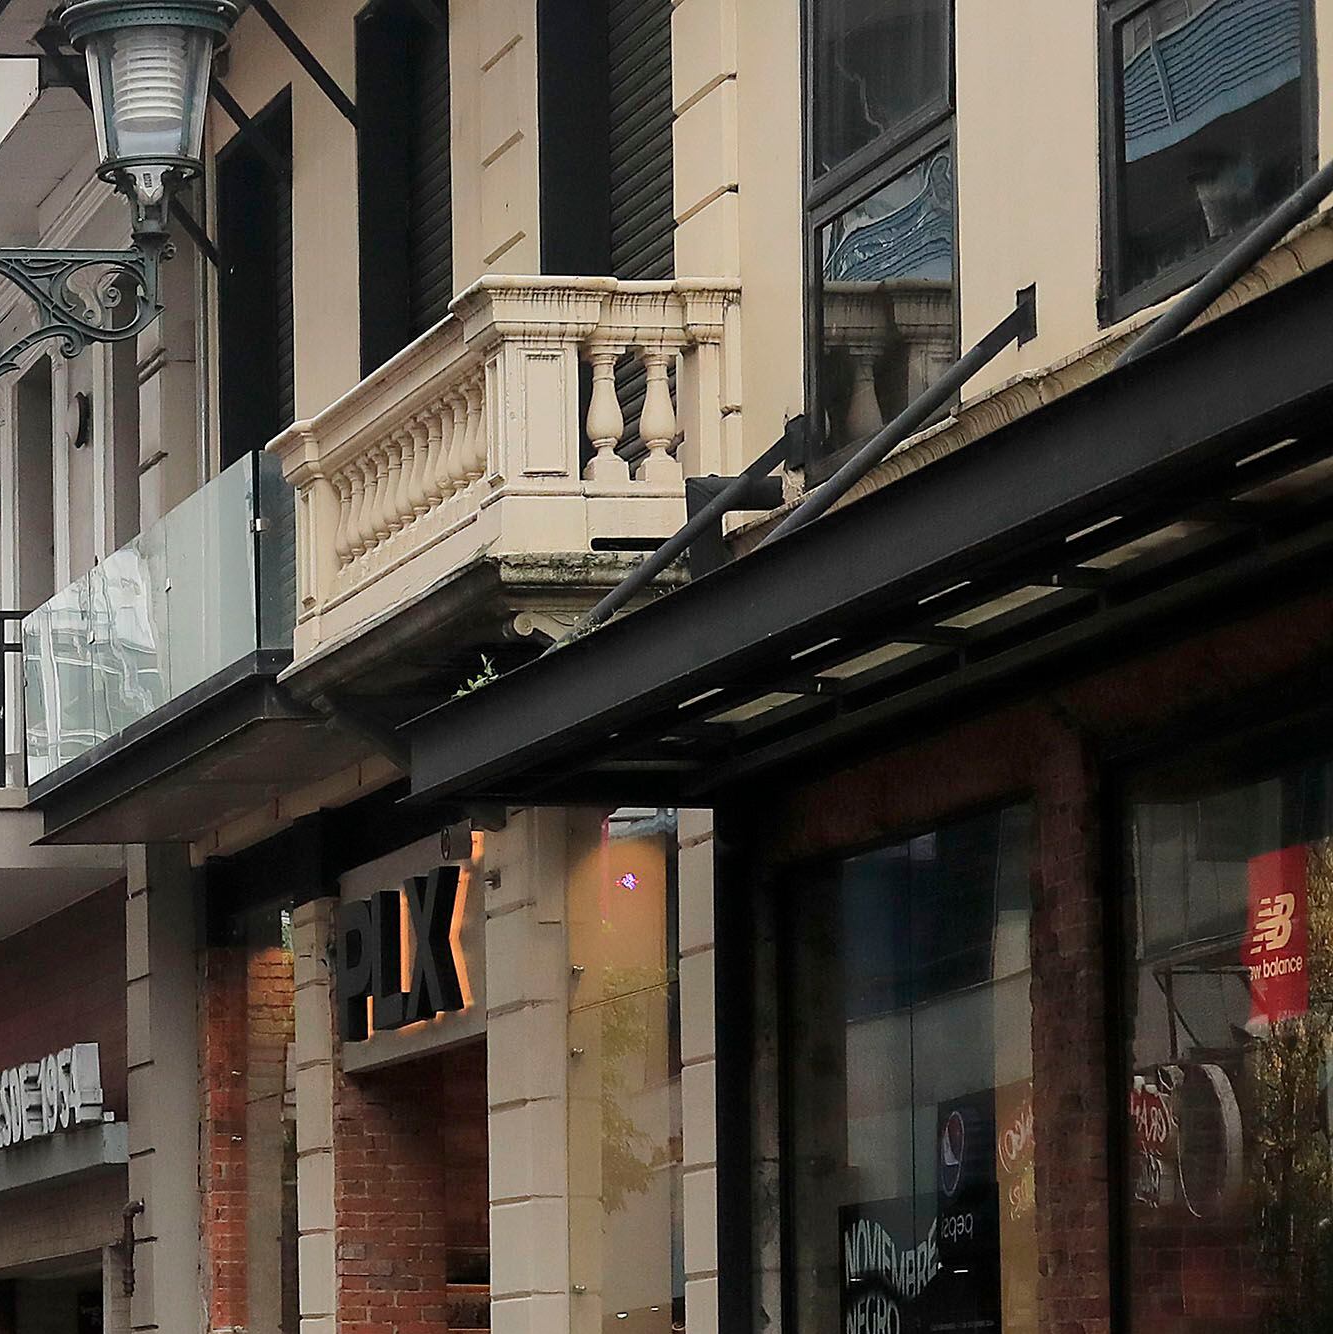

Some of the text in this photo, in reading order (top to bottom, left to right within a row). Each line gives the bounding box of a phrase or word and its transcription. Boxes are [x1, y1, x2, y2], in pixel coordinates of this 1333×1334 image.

[336, 866, 466, 1042] PLX
[1263, 955, 1303, 978] balance
[845, 1216, 941, 1298] NOVIEMBRE
